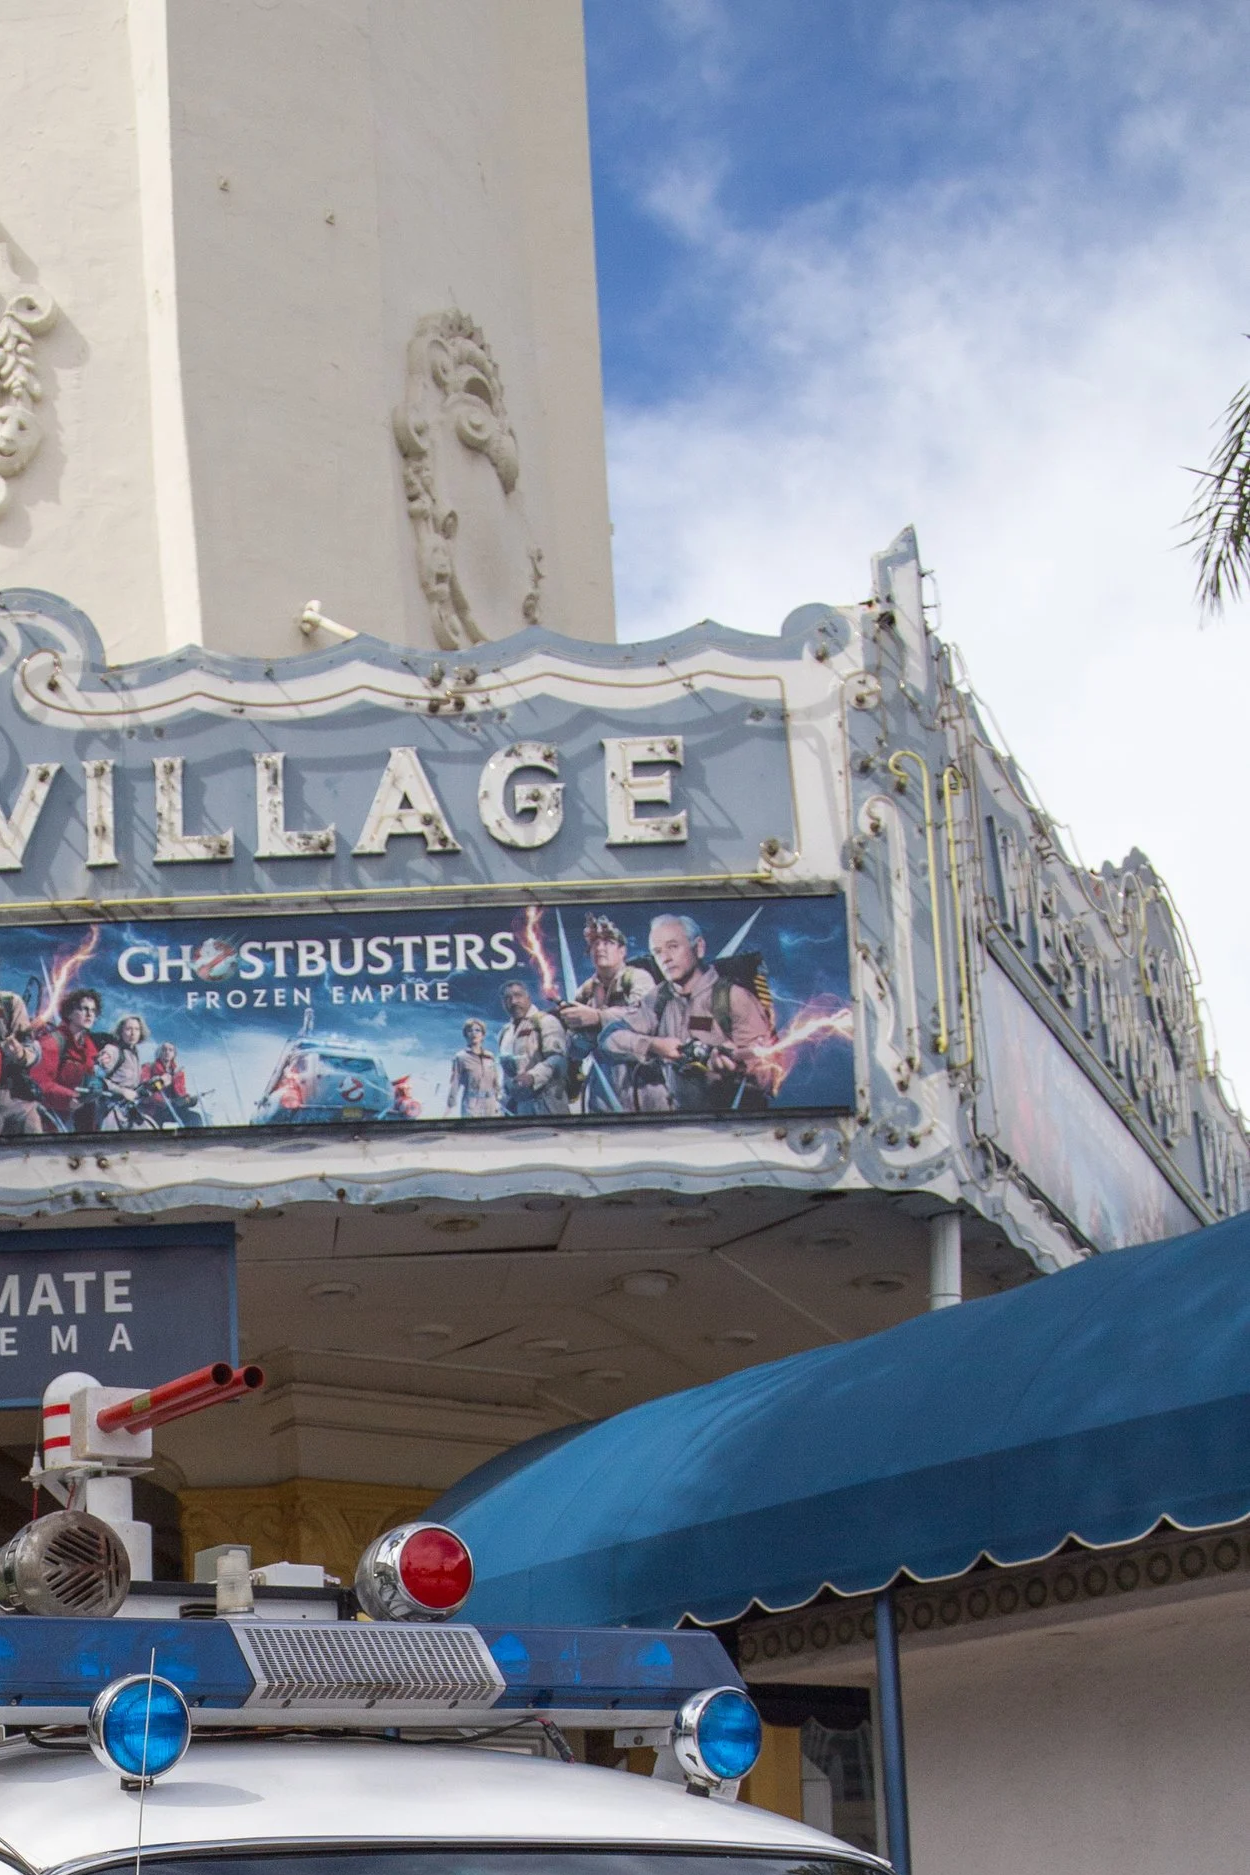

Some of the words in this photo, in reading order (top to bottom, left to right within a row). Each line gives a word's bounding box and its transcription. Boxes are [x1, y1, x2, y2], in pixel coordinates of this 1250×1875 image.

[117, 931, 518, 985] GHOSTBUSTERS
[186, 987, 312, 1011] FROZEN
[333, 982, 450, 1005] EMPIRE
